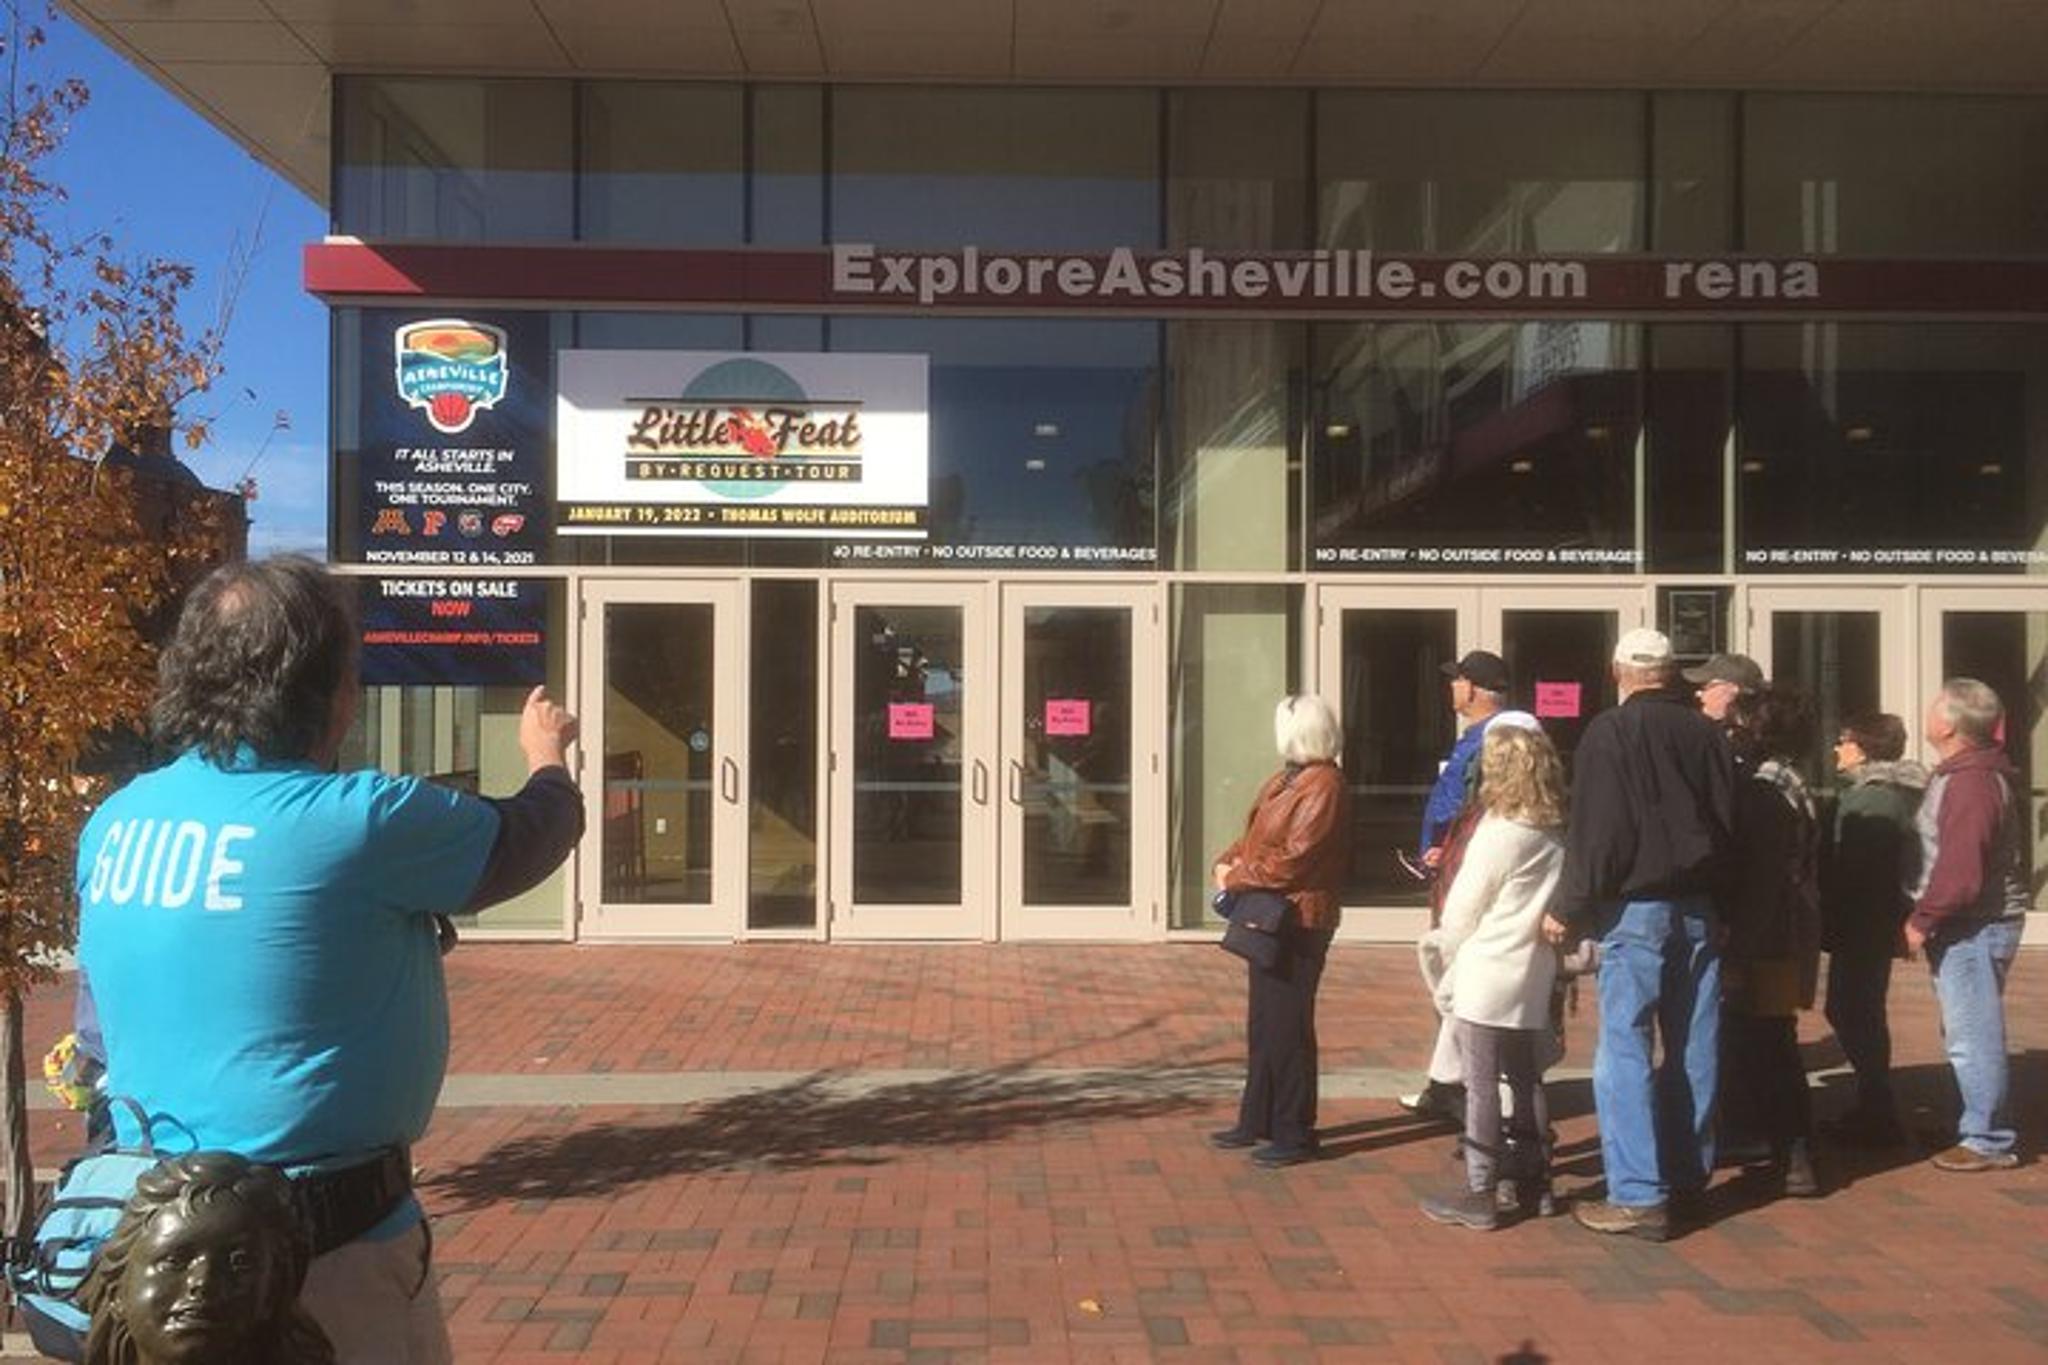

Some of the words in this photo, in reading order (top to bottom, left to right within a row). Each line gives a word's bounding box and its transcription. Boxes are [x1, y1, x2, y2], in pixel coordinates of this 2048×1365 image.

[832, 243, 1587, 303] ExploreAsheville.com
[1665, 259, 1820, 299] rena
[627, 406, 731, 451] Little
[764, 408, 863, 451] Feat
[395, 449, 410, 460] IT
[411, 449, 437, 461] ALL
[443, 450, 494, 462] STARTS
[497, 450, 514, 461] IN
[639, 465, 668, 478] BY
[680, 465, 784, 480] REQUEST
[797, 466, 850, 479] TOUR
[374, 481, 404, 493] THIS
[469, 482, 496, 494] ONE
[389, 494, 417, 505] ONE
[568, 507, 631, 521] JANUARY
[637, 508, 658, 524] 19,
[722, 508, 777, 523] THOMAS
[782, 508, 825, 523] WOLFE
[829, 509, 917, 525] AUDITORIUM
[366, 551, 449, 563] NOVEMBER
[452, 551, 466, 563] 12
[503, 552, 534, 564] 2021
[853, 546, 922, 559] RE-ENTRY
[932, 546, 953, 559] NO
[955, 546, 1014, 560] OUTSIDE
[1018, 547, 1057, 560] FOOD
[1073, 548, 1158, 561] BEVERAGES
[1316, 548, 1336, 561] NO
[1339, 548, 1407, 562] RE-ENTRY
[1418, 549, 1440, 562] NO
[1442, 549, 1500, 563] OUTSIDE
[1504, 550, 1543, 562] FOOD
[1746, 550, 1767, 562] NO
[1771, 550, 1839, 563] RE-ENTRY
[1850, 550, 1871, 563] NO
[1874, 550, 1932, 564] OUTSIDE
[1937, 551, 1975, 563] FOOD
[380, 580, 447, 597] TICKETS
[450, 581, 473, 597] ON
[477, 582, 518, 598] SALE
[432, 601, 470, 616] NOW
[91, 819, 256, 911] GUIDE
